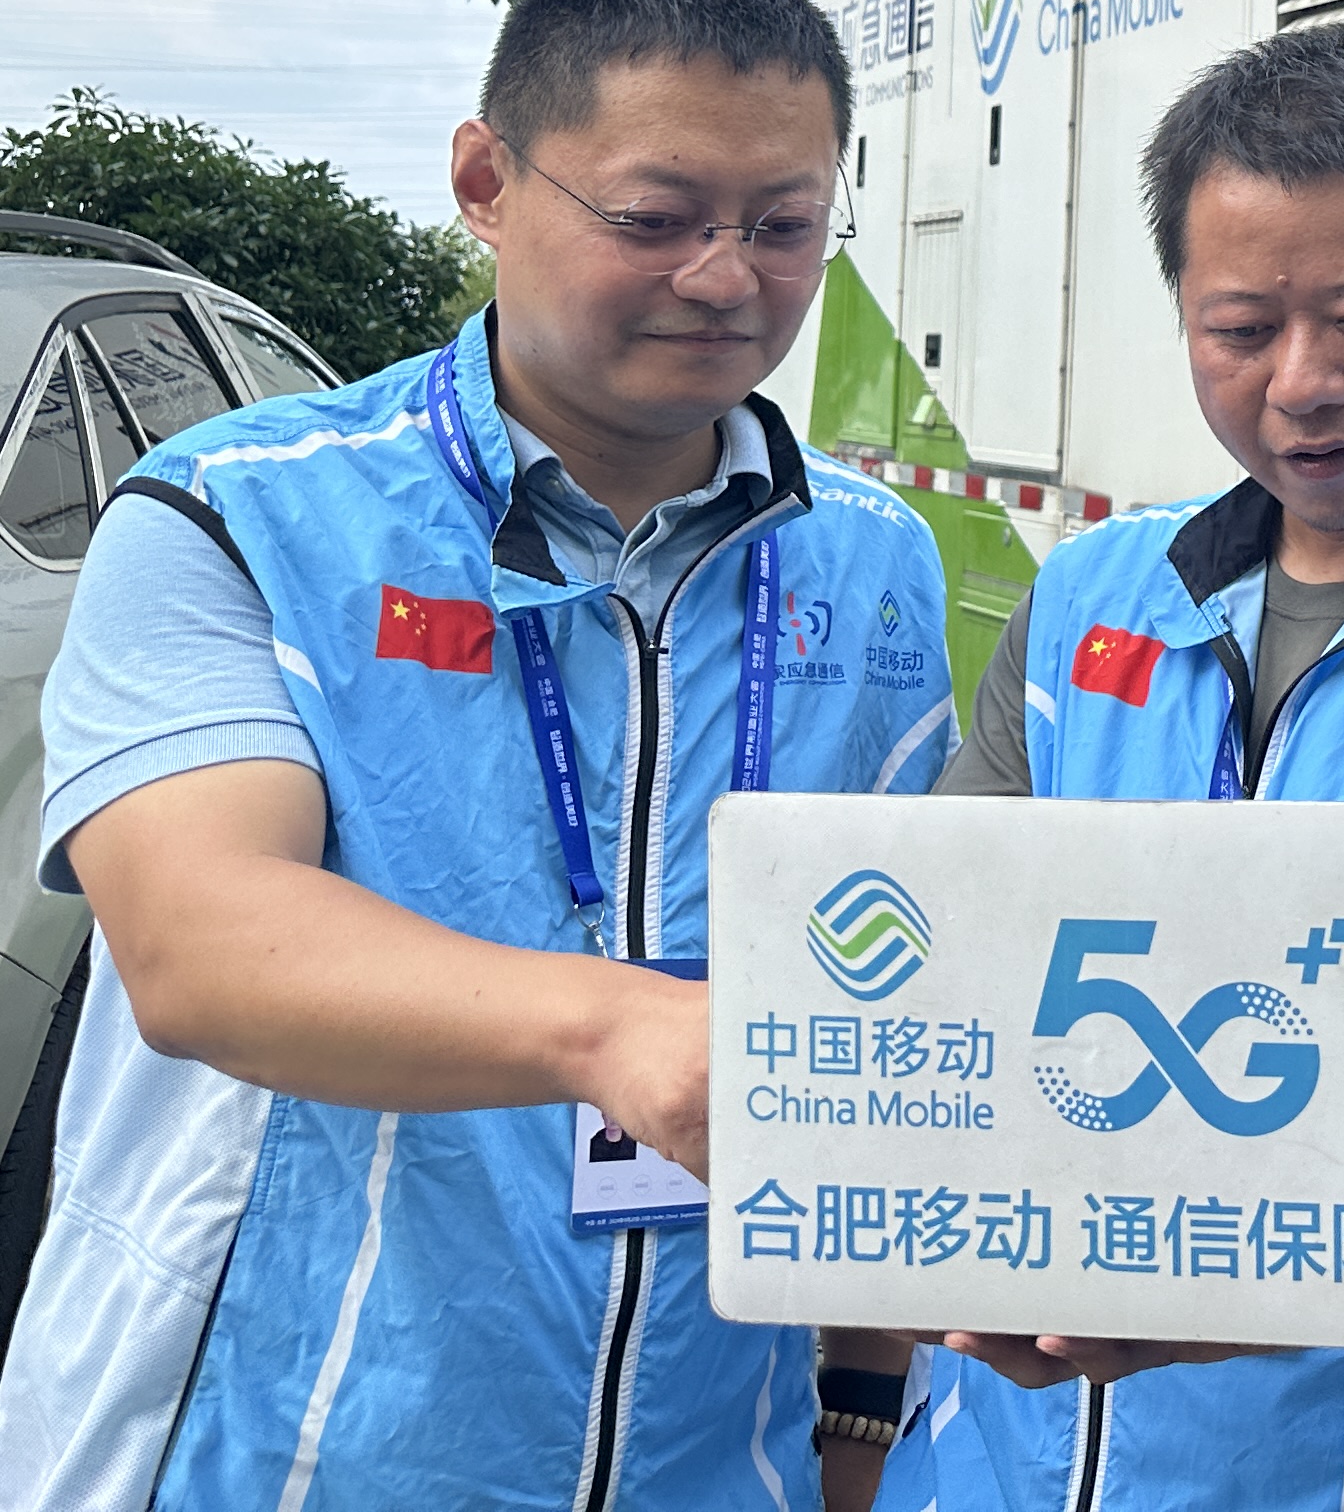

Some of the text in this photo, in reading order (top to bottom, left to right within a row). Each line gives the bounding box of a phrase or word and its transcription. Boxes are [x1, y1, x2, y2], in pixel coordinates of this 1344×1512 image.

[865, 642, 924, 673] 中国移动
[745, 1011, 994, 1080] 中国移动
[746, 1085, 994, 1130] China Mobile
[734, 1178, 1052, 1271] 合肥移动
